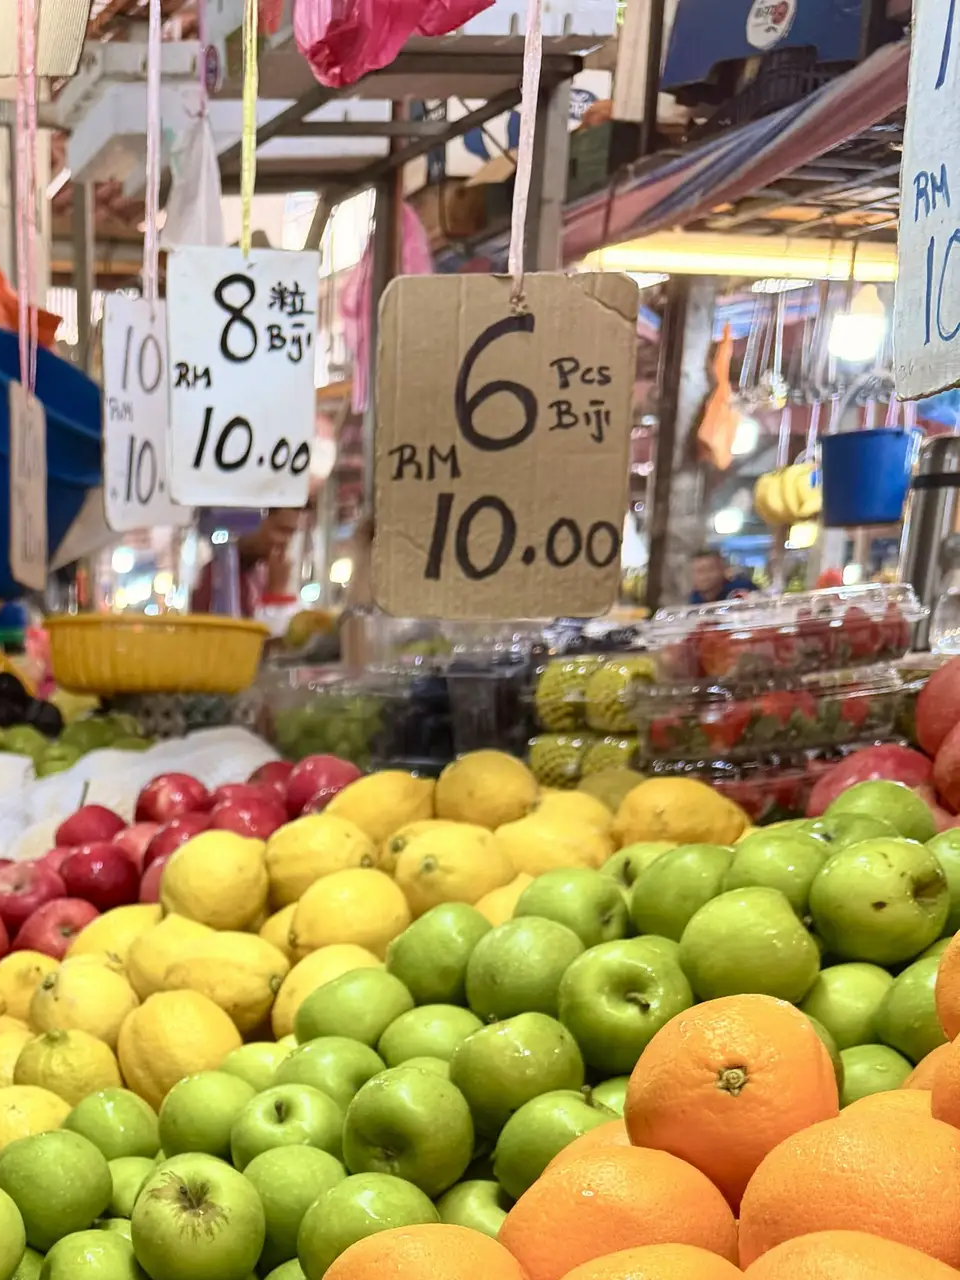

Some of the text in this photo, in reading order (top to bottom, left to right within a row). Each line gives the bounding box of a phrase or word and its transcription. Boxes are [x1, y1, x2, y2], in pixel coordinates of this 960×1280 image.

[913, 163, 951, 222] RM
[214, 273, 314, 364] 8 粒
[266, 322, 312, 364] Biji
[122, 325, 163, 394] 10
[173, 362, 212, 391] RM
[454, 313, 612, 451] 6 Pcs
[192, 406, 311, 476] 10.00
[548, 400, 611, 443] Biji
[387, 443, 462, 481] RM
[423, 492, 621, 581] 10.00
